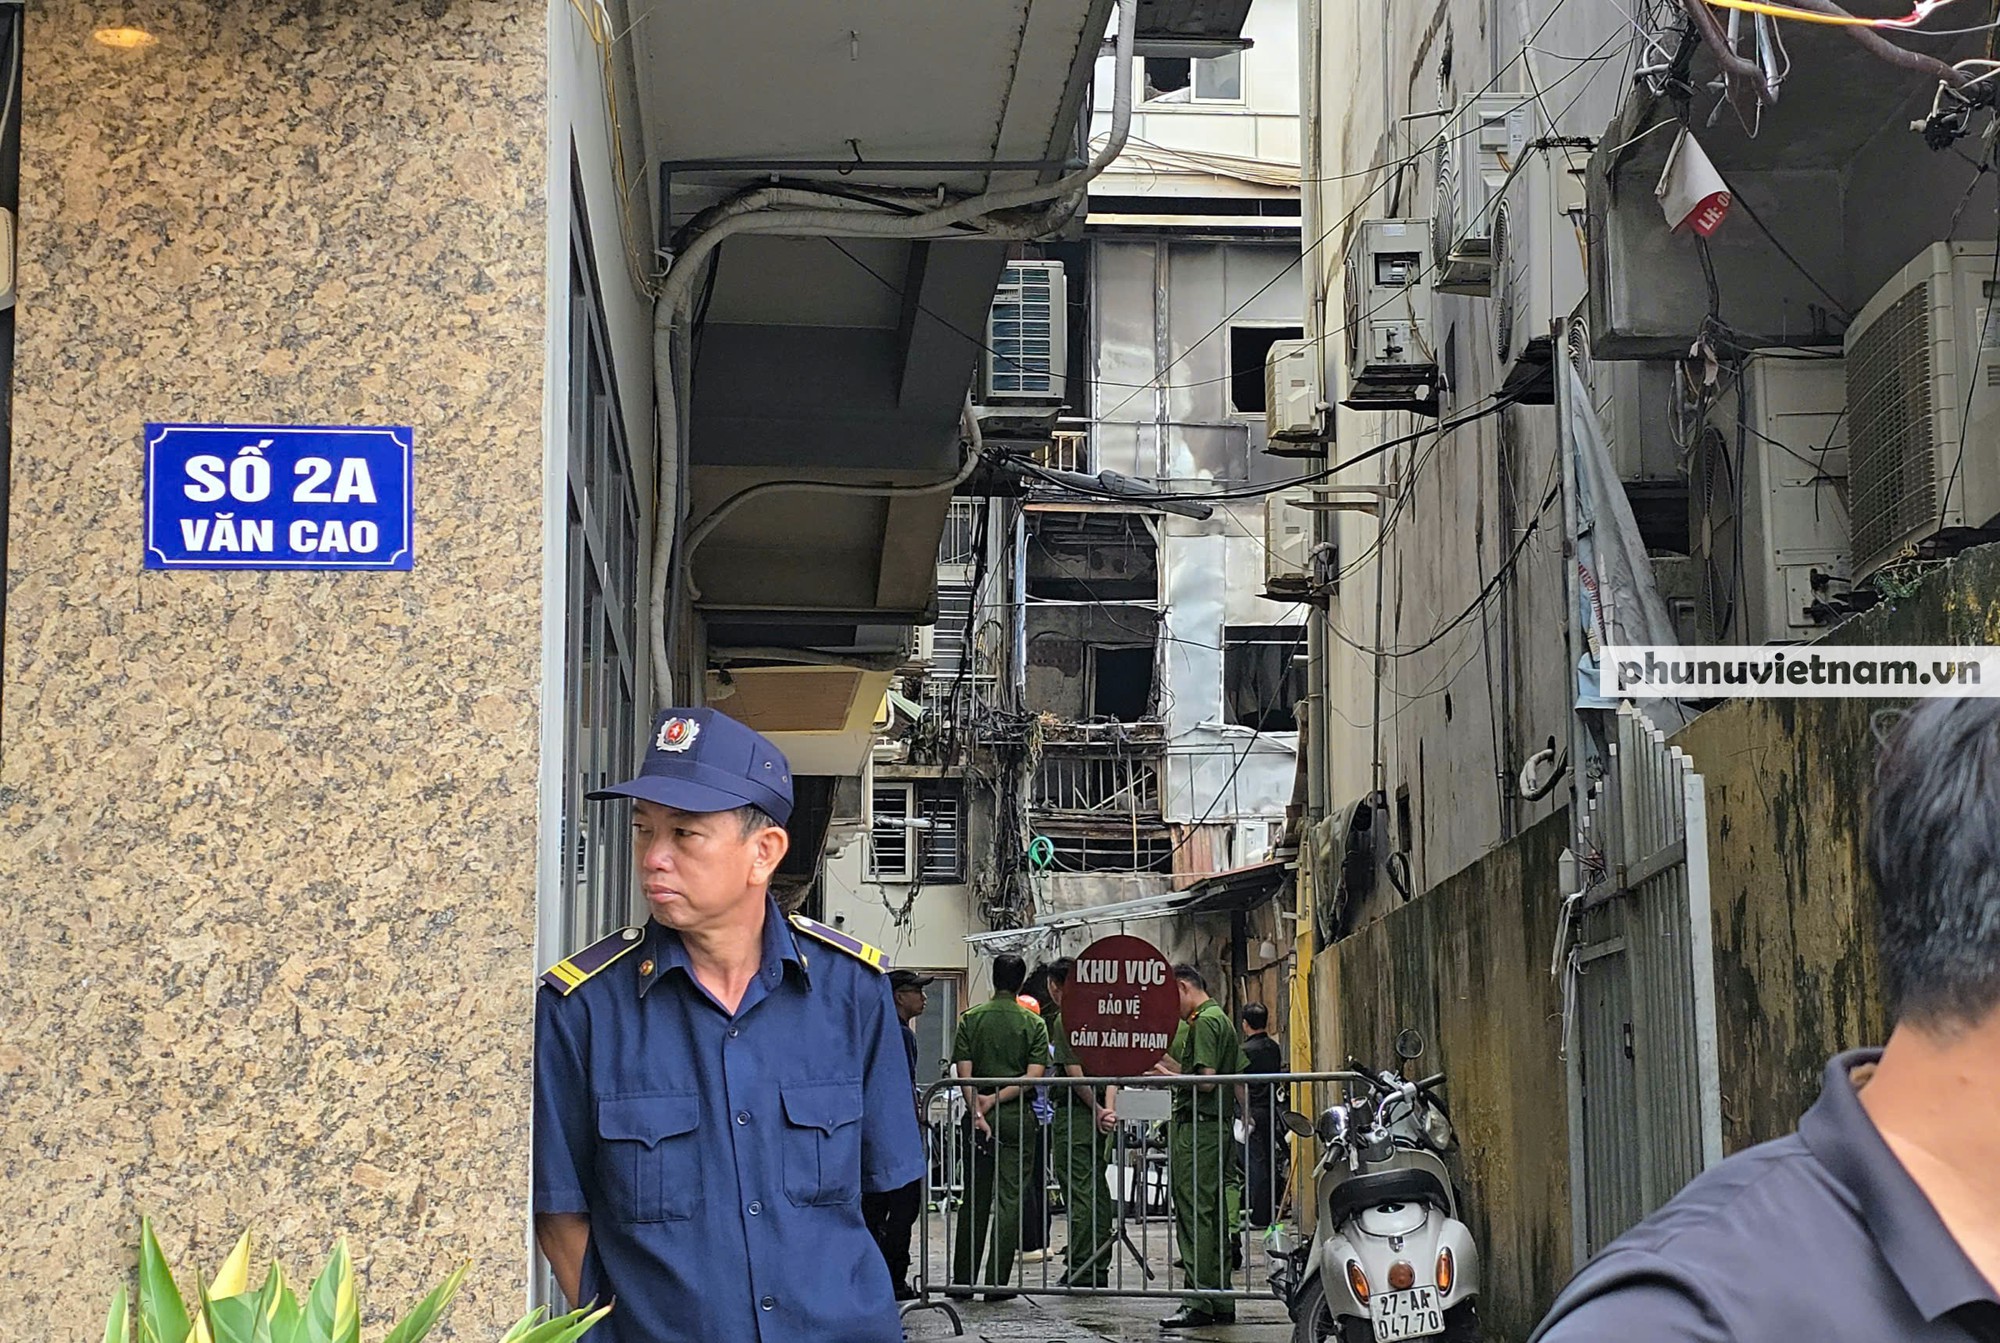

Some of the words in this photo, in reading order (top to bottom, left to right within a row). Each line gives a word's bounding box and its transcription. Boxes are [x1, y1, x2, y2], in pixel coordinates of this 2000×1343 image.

[1697, 206, 1723, 231] LH:
[184, 439, 274, 502] SỐ
[293, 457, 377, 503] 2A
[180, 512, 273, 552] VĂN
[289, 520, 378, 553] CAO
[1076, 959, 1118, 984] KHU
[1125, 959, 1166, 991] VỰC
[1098, 993, 1122, 1015] BẢO
[1125, 995, 1141, 1019] VỆ
[1070, 1024, 1098, 1047] CẤM
[1101, 1028, 1129, 1048] XÂM
[1132, 1032, 1168, 1052] PHẠM
[1378, 1310, 1439, 1339] 047.70
